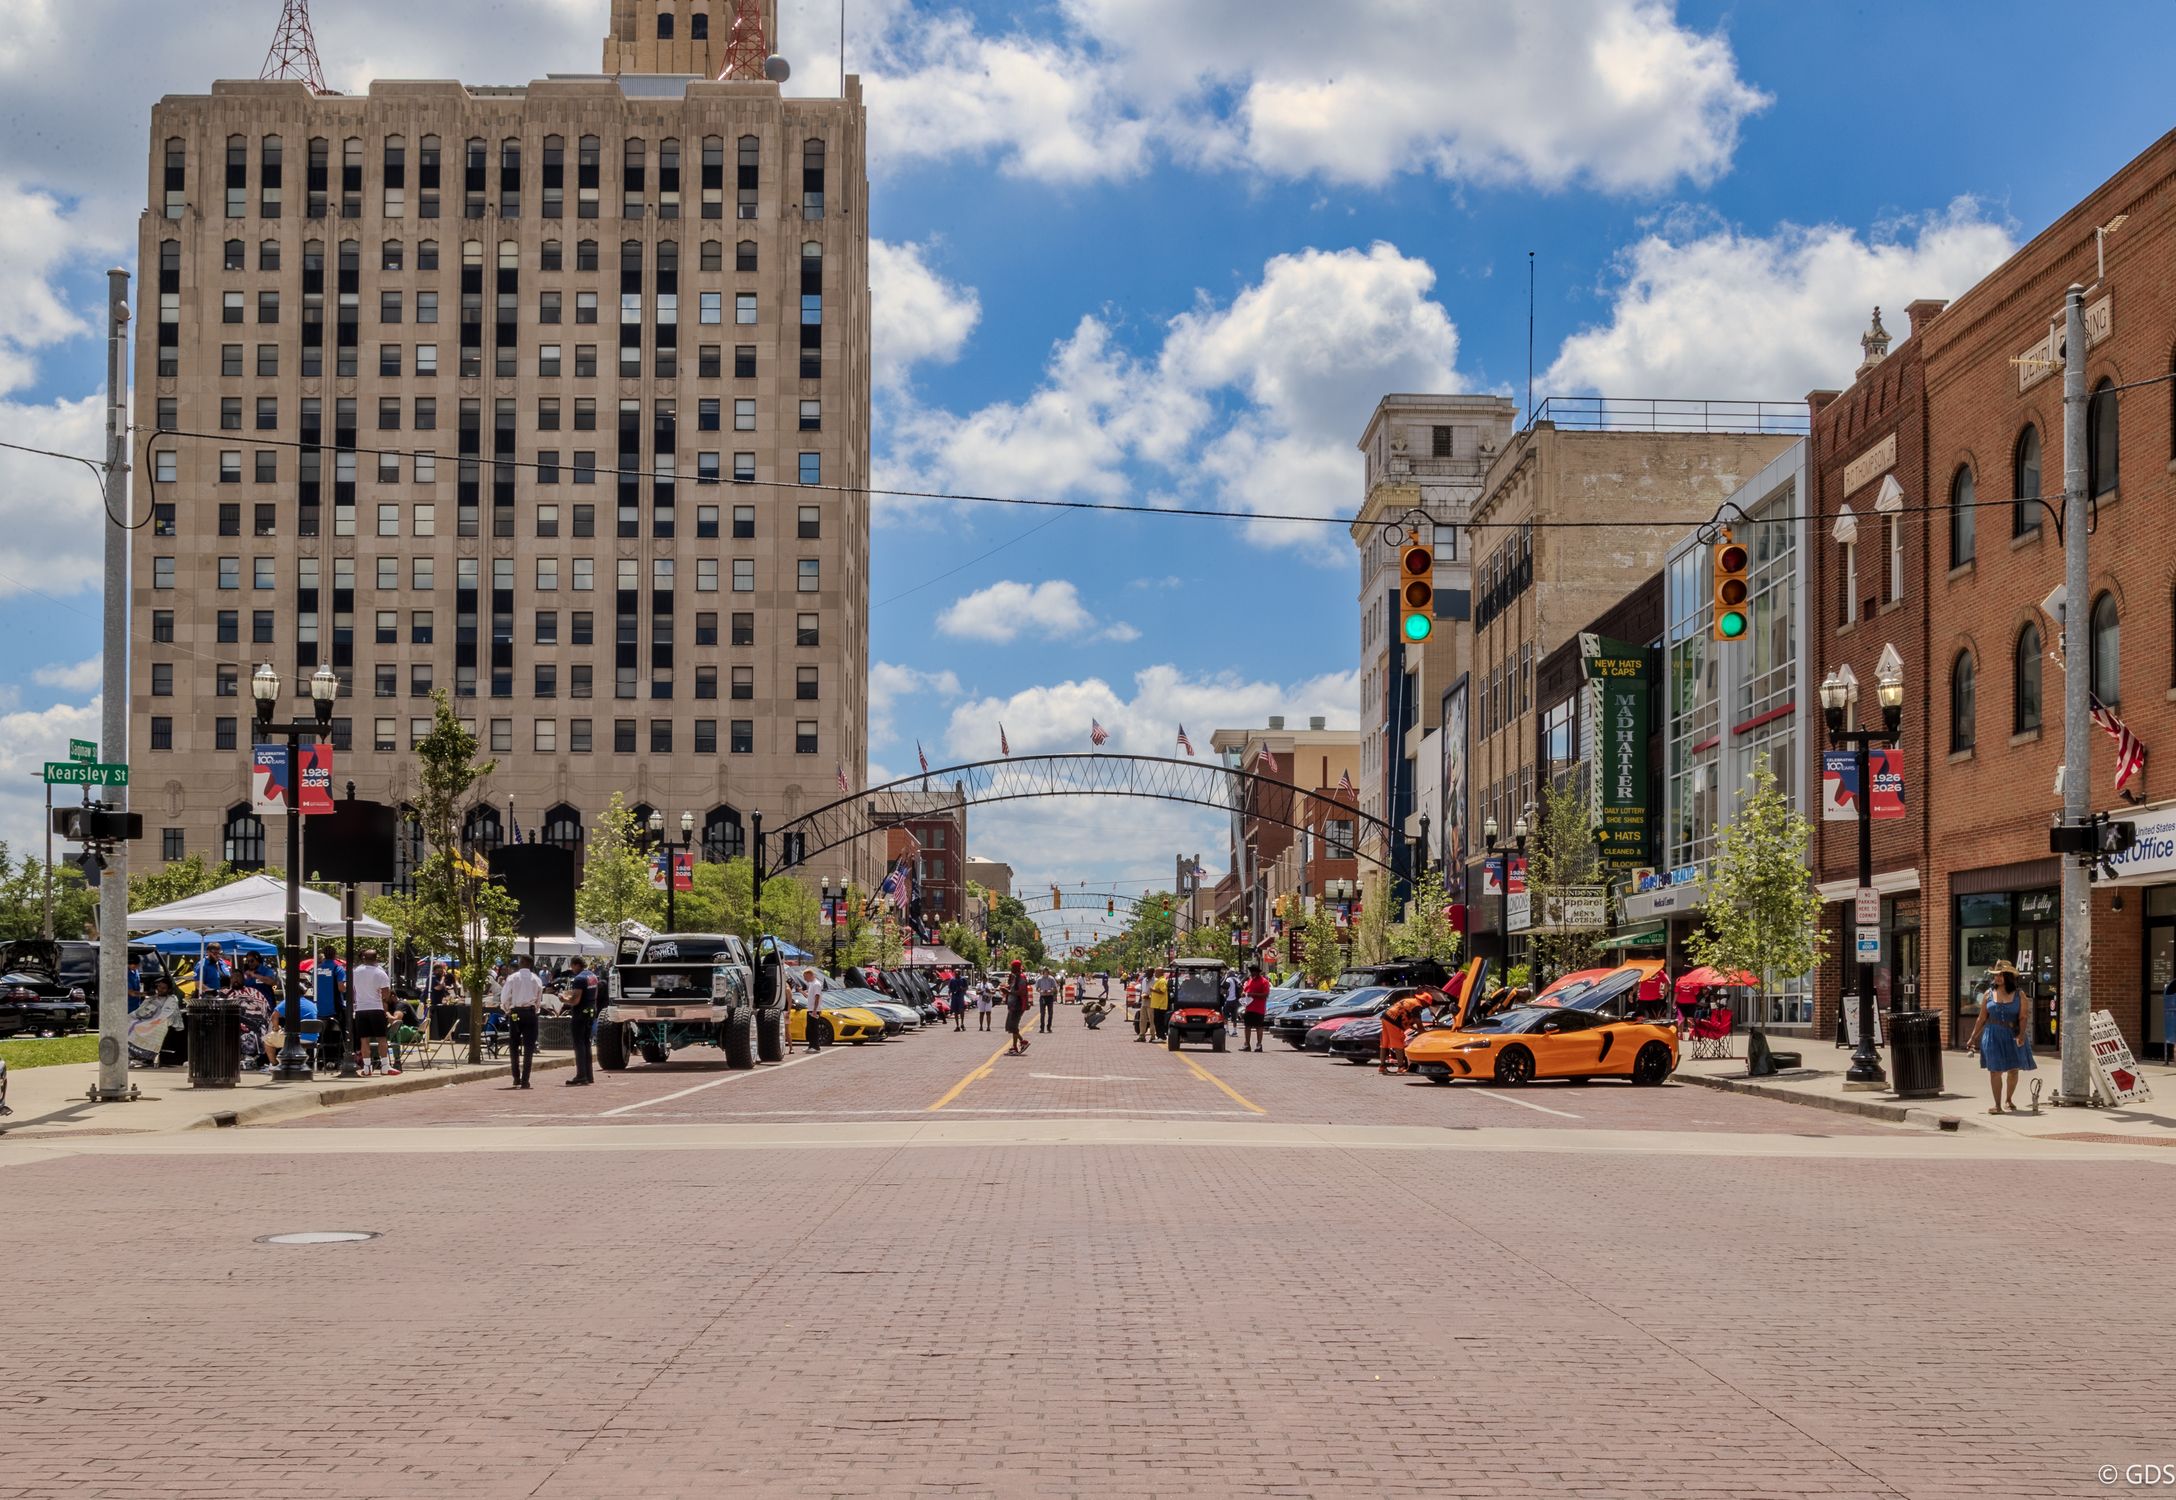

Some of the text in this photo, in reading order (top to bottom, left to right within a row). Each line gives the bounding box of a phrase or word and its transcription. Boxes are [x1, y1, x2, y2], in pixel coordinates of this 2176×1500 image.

[1595, 659, 1642, 668] NEW HATS
[1611, 668, 1636, 676] CAPS
[71, 741, 91, 760] Saginaw
[47, 765, 126, 785] Kearsley St
[302, 768, 328, 777] 1926
[1872, 773, 1901, 782] 1926
[301, 779, 330, 787] 2026
[1872, 783, 1902, 792] 2026
[2136, 822, 2175, 837] United States
[1614, 831, 1641, 841] HATS
[2131, 837, 2174, 861] Office
[1564, 898, 1602, 908] apparel
[1566, 916, 1602, 924] CLOTHING
[2118, 1038, 2126, 1049] &
[2097, 1055, 2117, 1066] BARBER
[2118, 1051, 2131, 1062] SHOP
